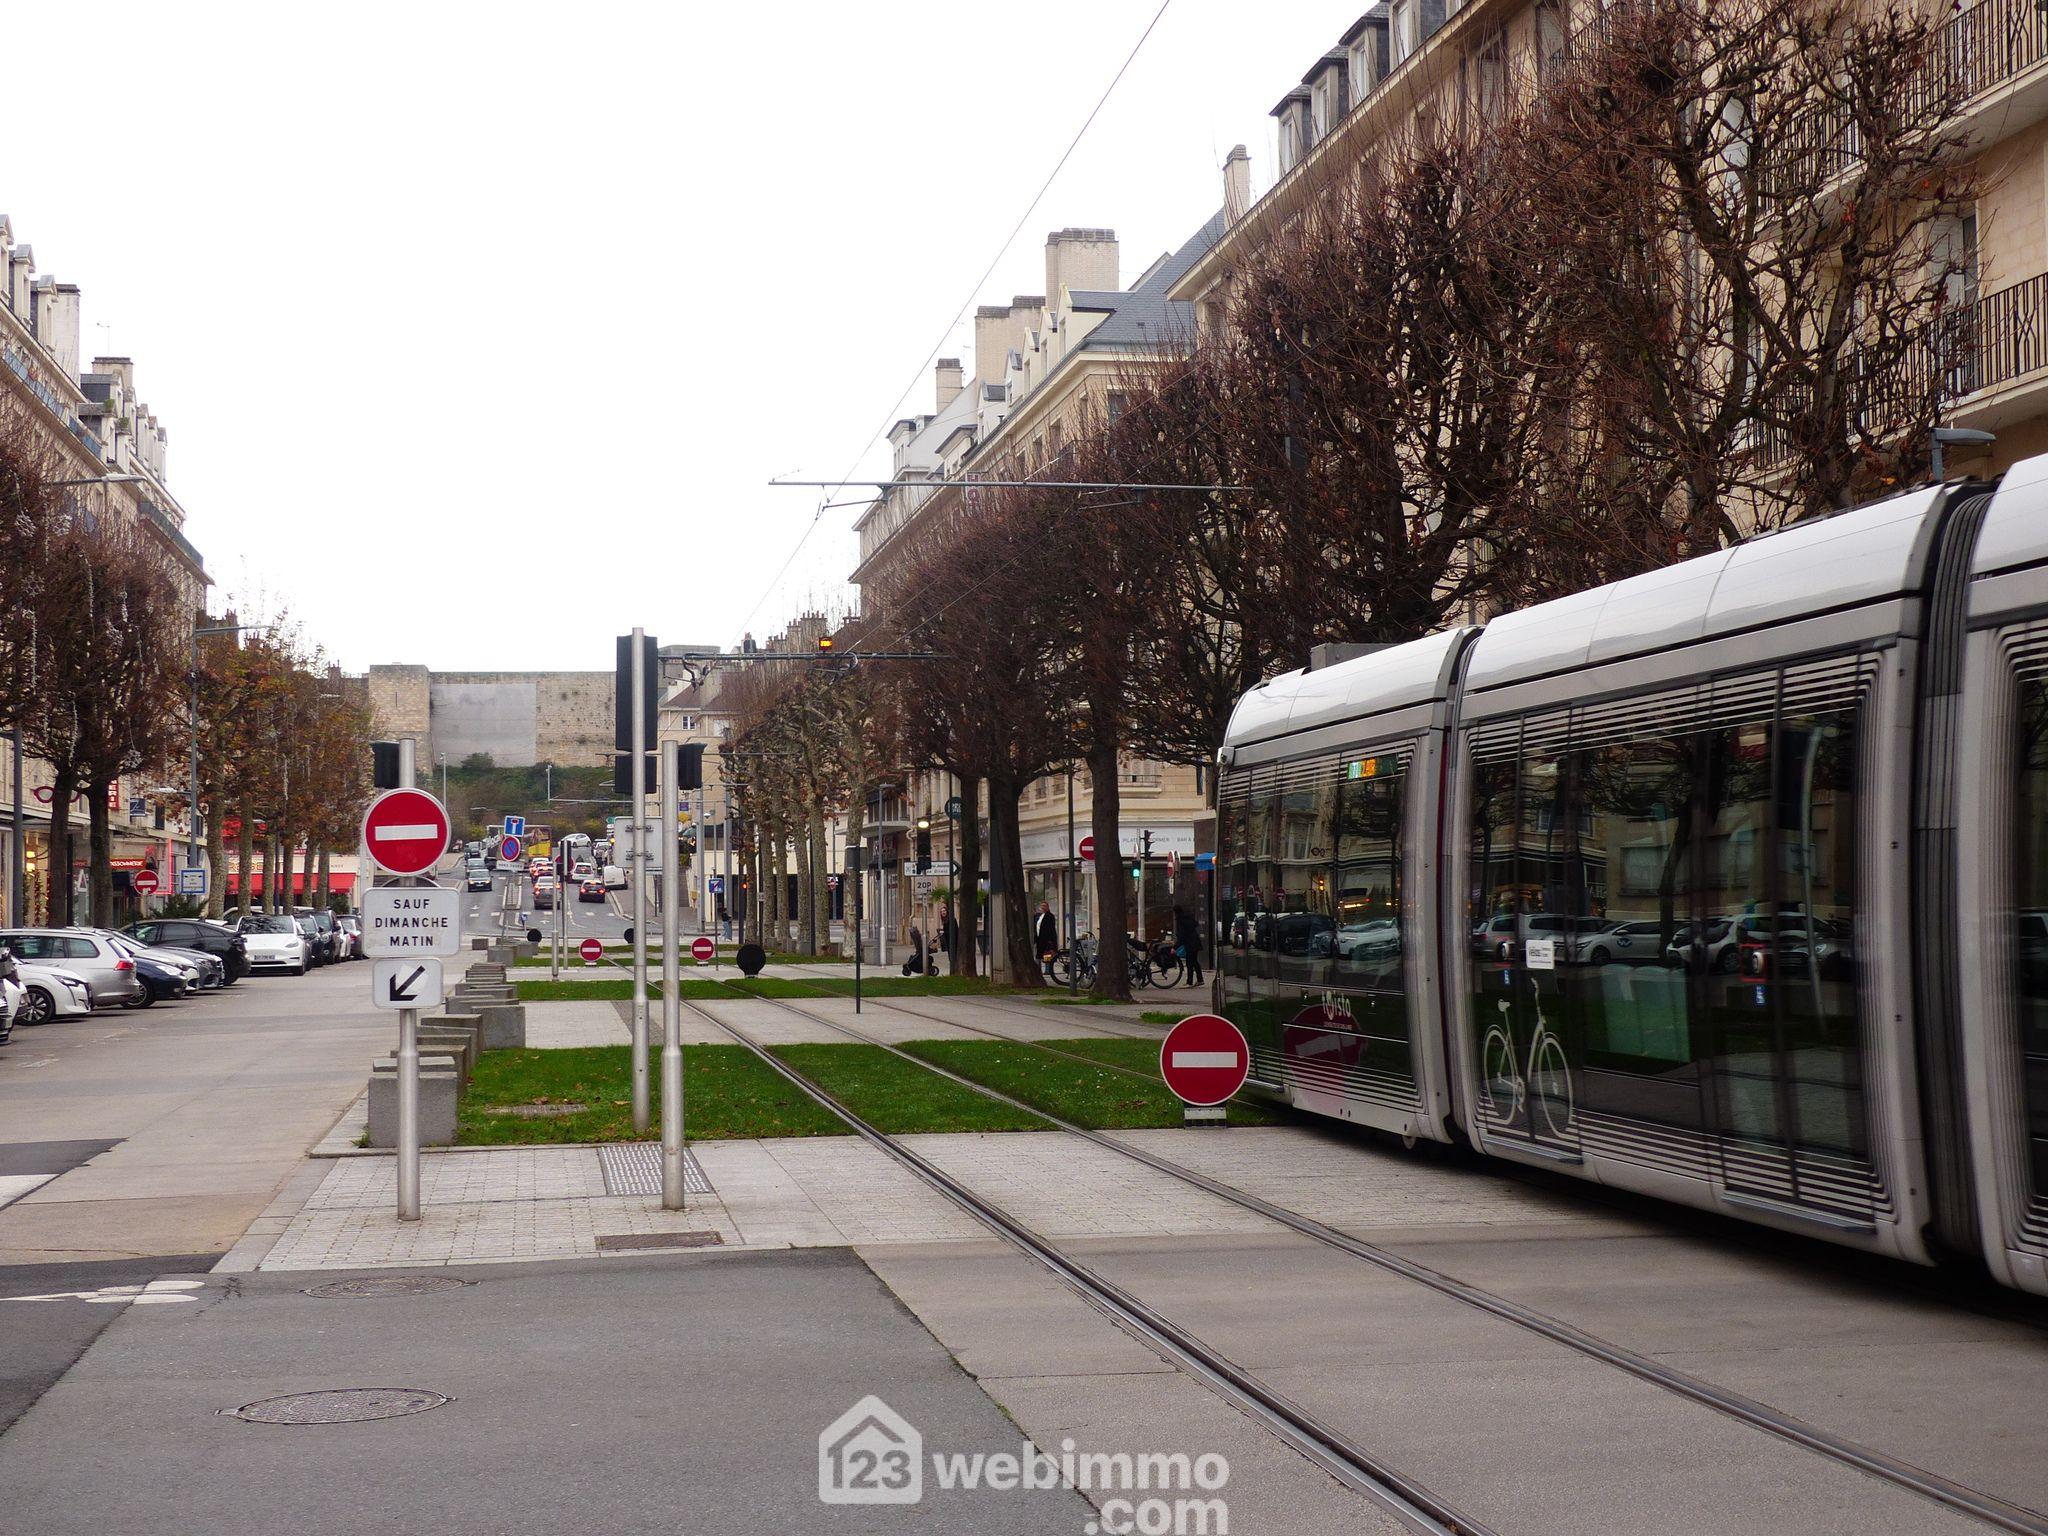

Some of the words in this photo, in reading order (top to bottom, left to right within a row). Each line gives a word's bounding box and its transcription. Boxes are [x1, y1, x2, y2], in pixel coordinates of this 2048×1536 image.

[393, 898, 430, 910] SAUF
[375, 917, 448, 928] DIMANCHE
[390, 936, 433, 946] MATIN
